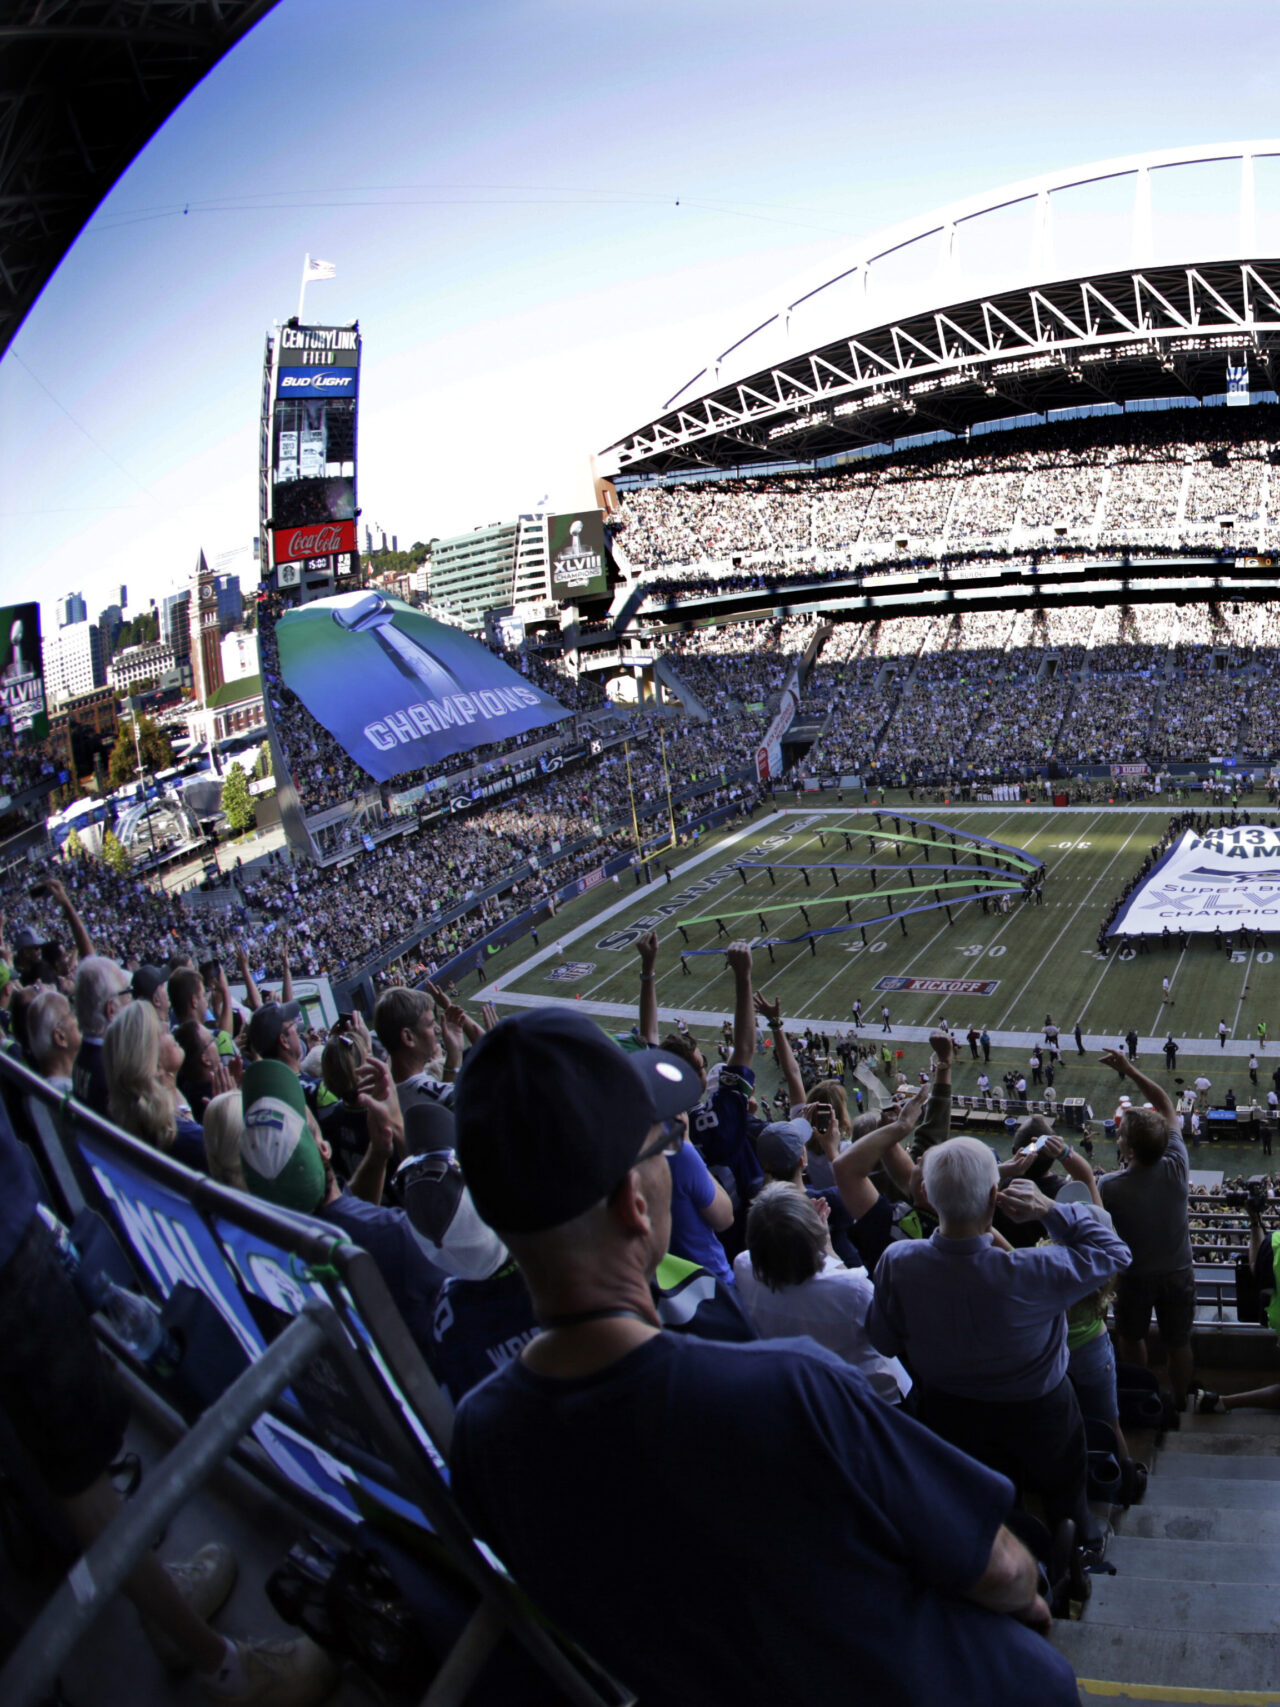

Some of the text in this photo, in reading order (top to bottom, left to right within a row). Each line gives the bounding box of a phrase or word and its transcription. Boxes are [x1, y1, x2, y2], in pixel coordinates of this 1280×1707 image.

[282, 327, 357, 350] CENTURYLINK
[302, 351, 335, 364] FIELD
[281, 376, 352, 387] BUD LIGHT
[553, 555, 601, 574] XLVIII
[556, 568, 600, 580] CHAMPIONS
[364, 686, 541, 751] CHAMPIONS
[482, 776, 513, 799] HAWKS
[1163, 884, 1249, 895] SUPER
[963, 944, 1007, 957] 30
[1230, 951, 1275, 964] 50
[910, 980, 981, 993] KICKOFF
[418, 1081, 448, 1100] 12
